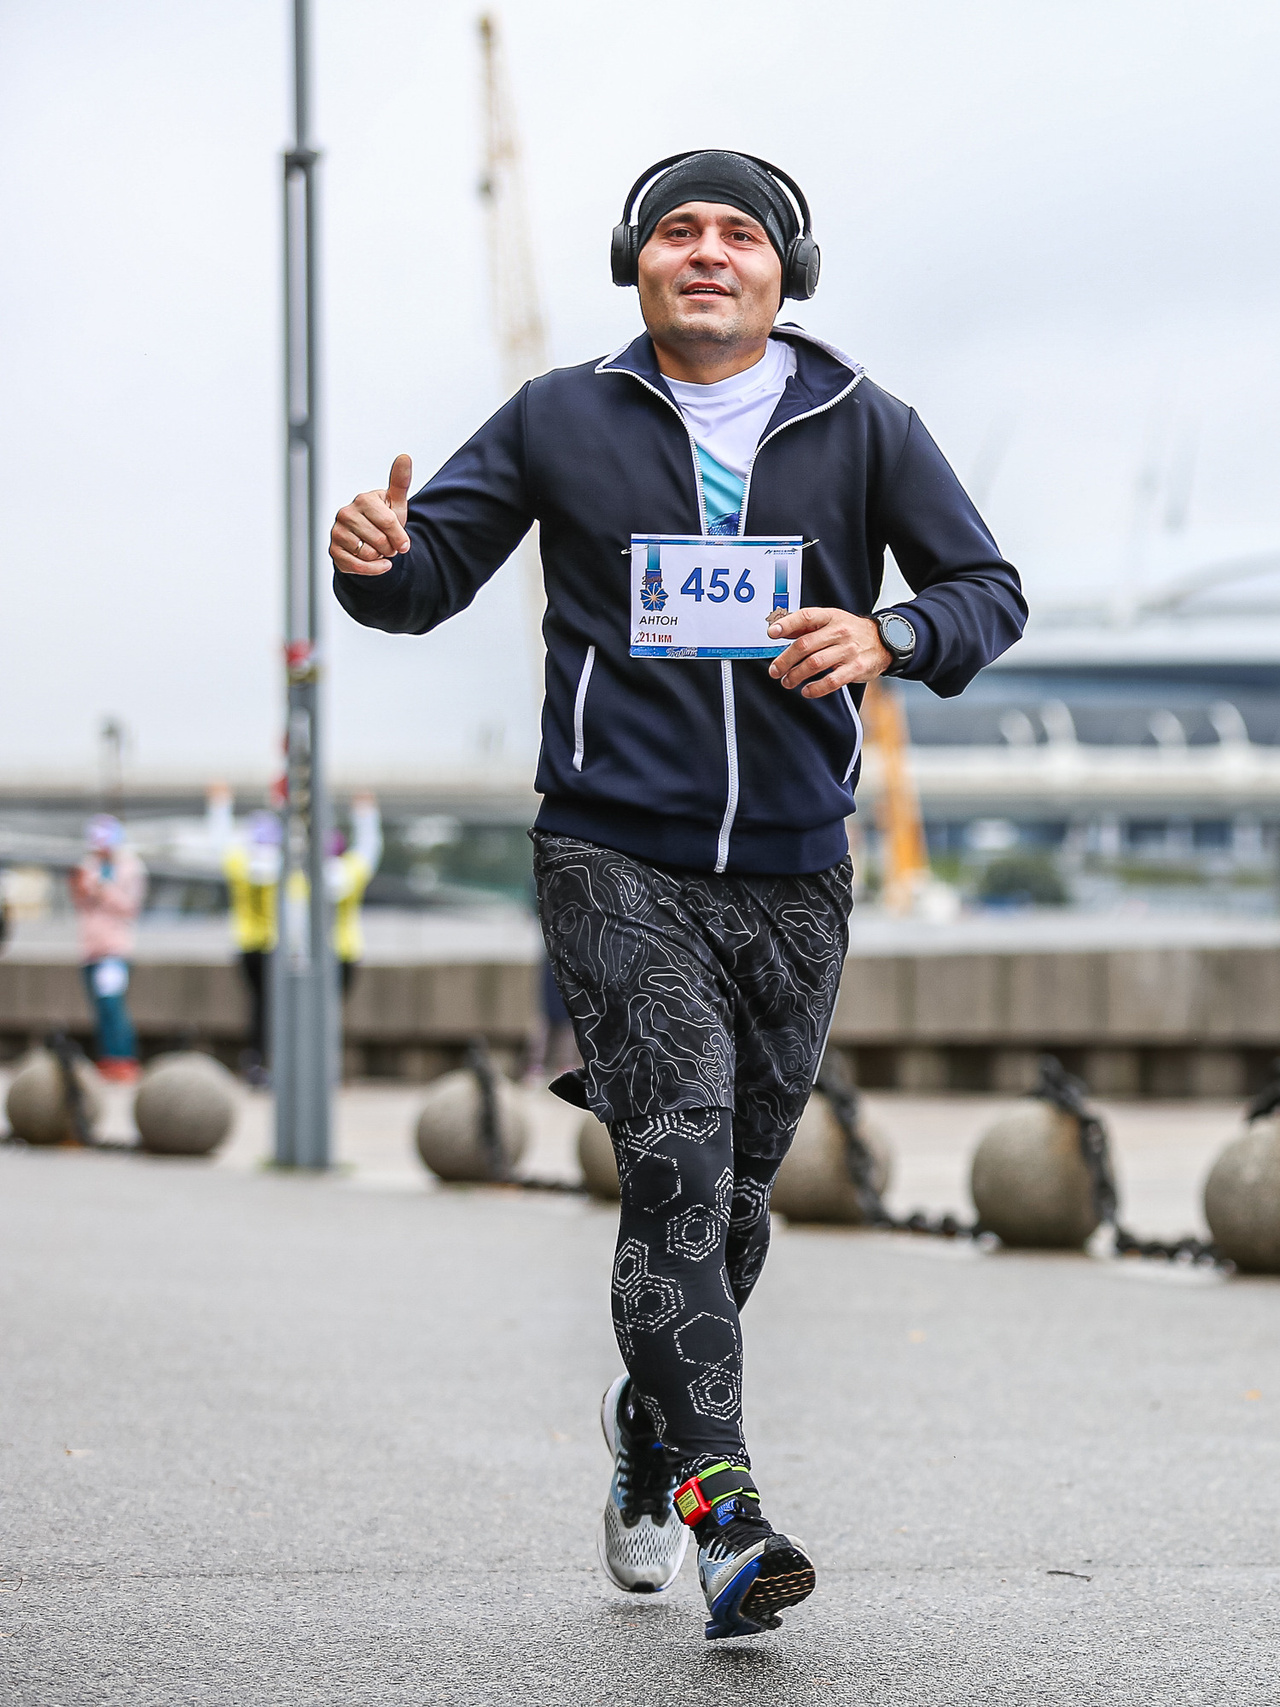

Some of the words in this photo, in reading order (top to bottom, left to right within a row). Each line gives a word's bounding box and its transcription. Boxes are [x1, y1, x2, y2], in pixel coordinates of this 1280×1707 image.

[680, 567, 755, 603] 456
[639, 615, 678, 626] АНТОН
[640, 632, 656, 643] 21.1
